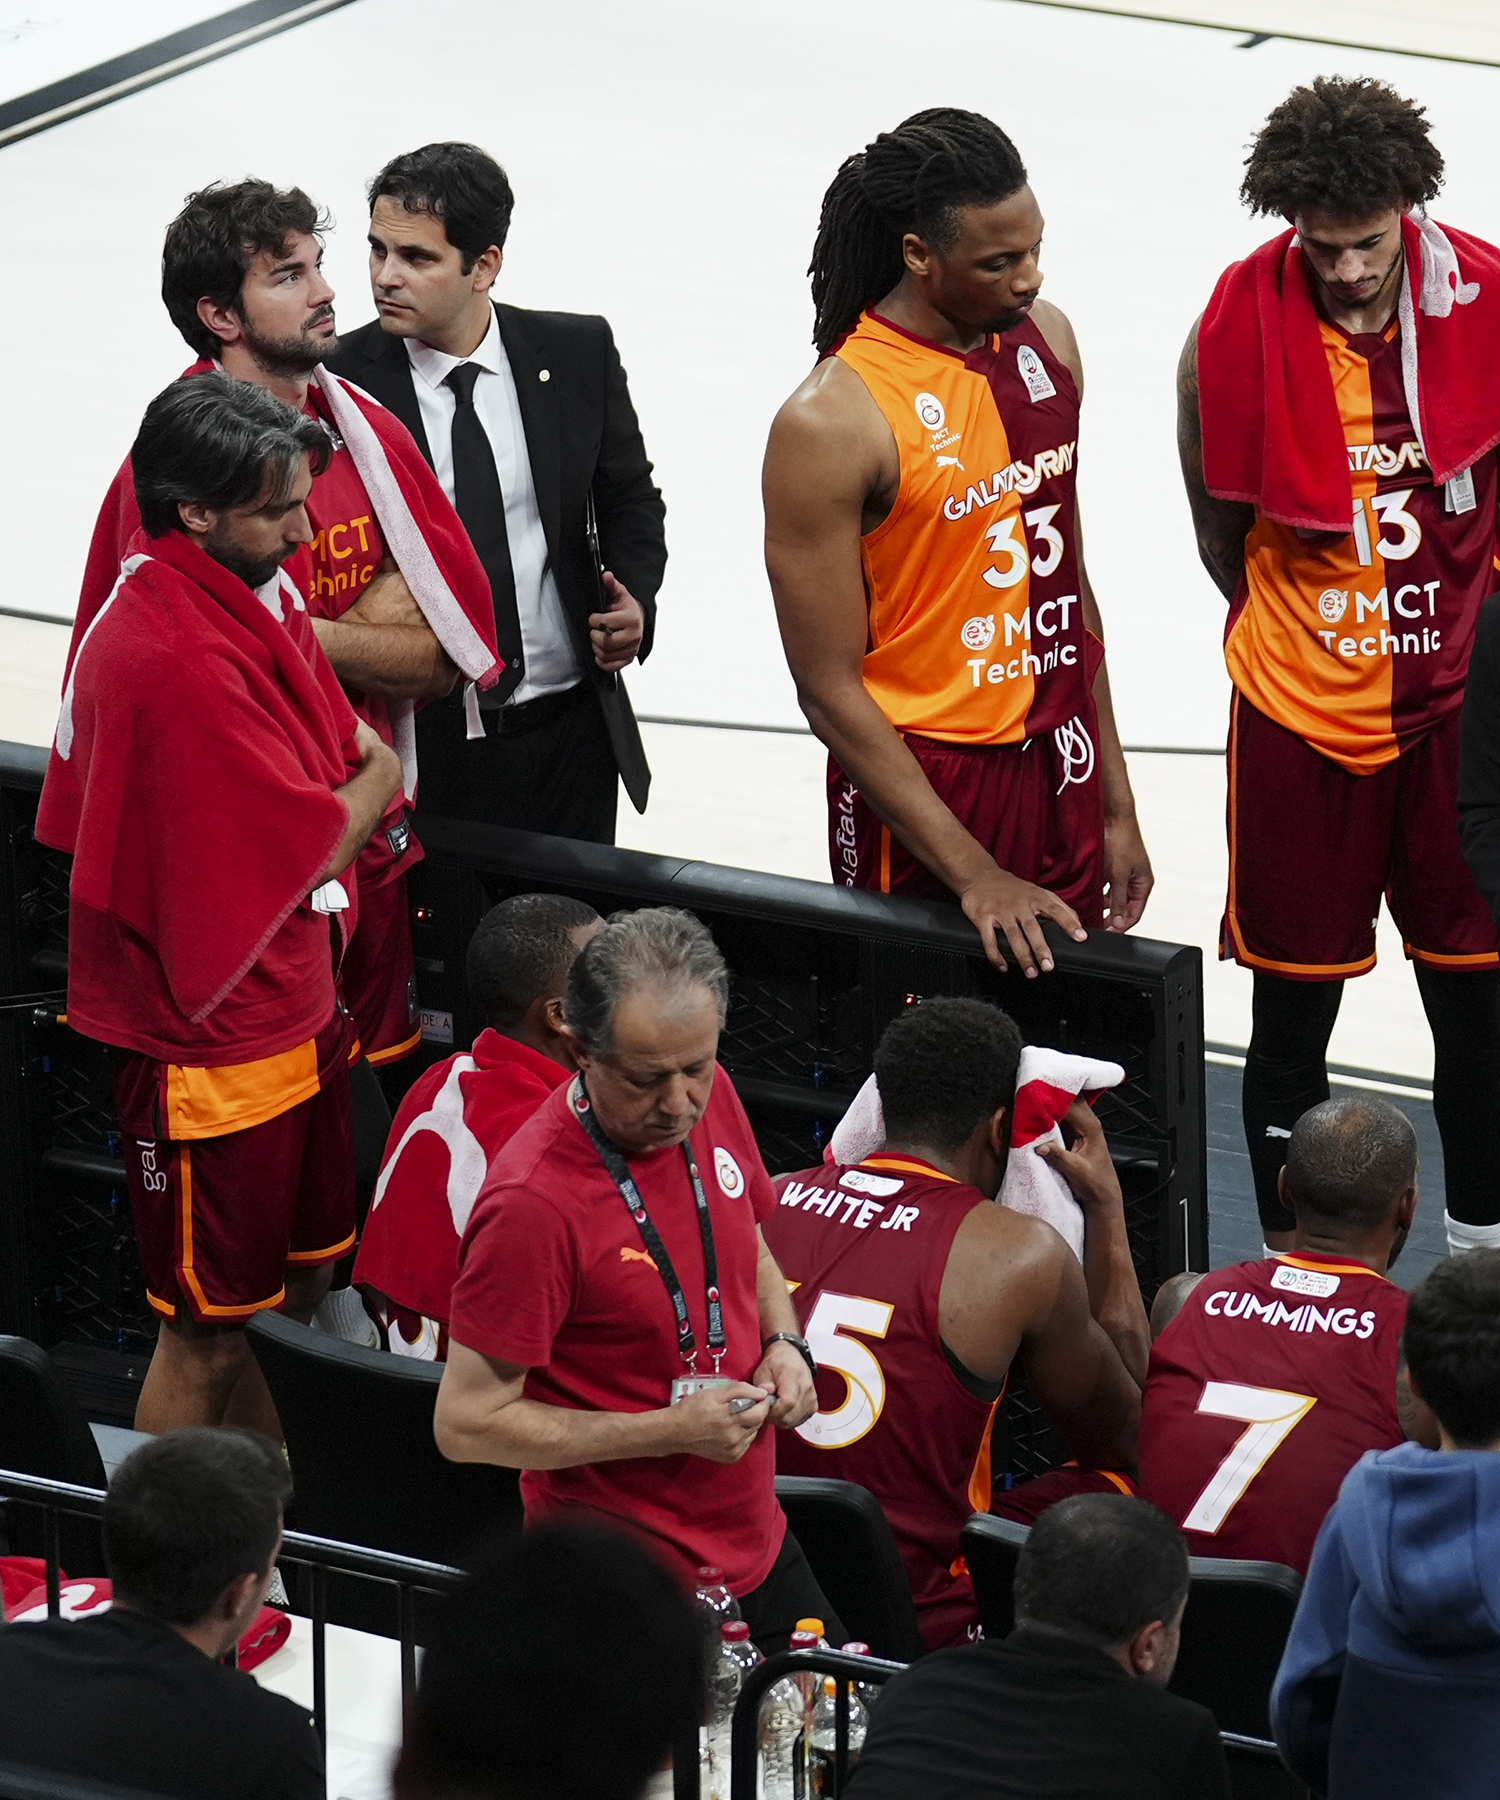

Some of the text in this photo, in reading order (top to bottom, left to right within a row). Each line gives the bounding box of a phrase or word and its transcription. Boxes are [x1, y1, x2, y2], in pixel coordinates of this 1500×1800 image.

[931, 427, 950, 442] MCT
[942, 440, 1077, 521] GALATASARAY
[981, 503, 1064, 588] 33
[1352, 488, 1422, 567] 13
[1003, 594, 1077, 646] MCT
[1355, 580, 1441, 624] MCT
[967, 641, 1077, 688] Technic
[1318, 628, 1441, 659] Technic
[779, 1181, 920, 1232] WHITE JR
[1204, 1290, 1376, 1339] CUMMINGS
[787, 1282, 895, 1450] 5
[1181, 1379, 1319, 1537] 7
